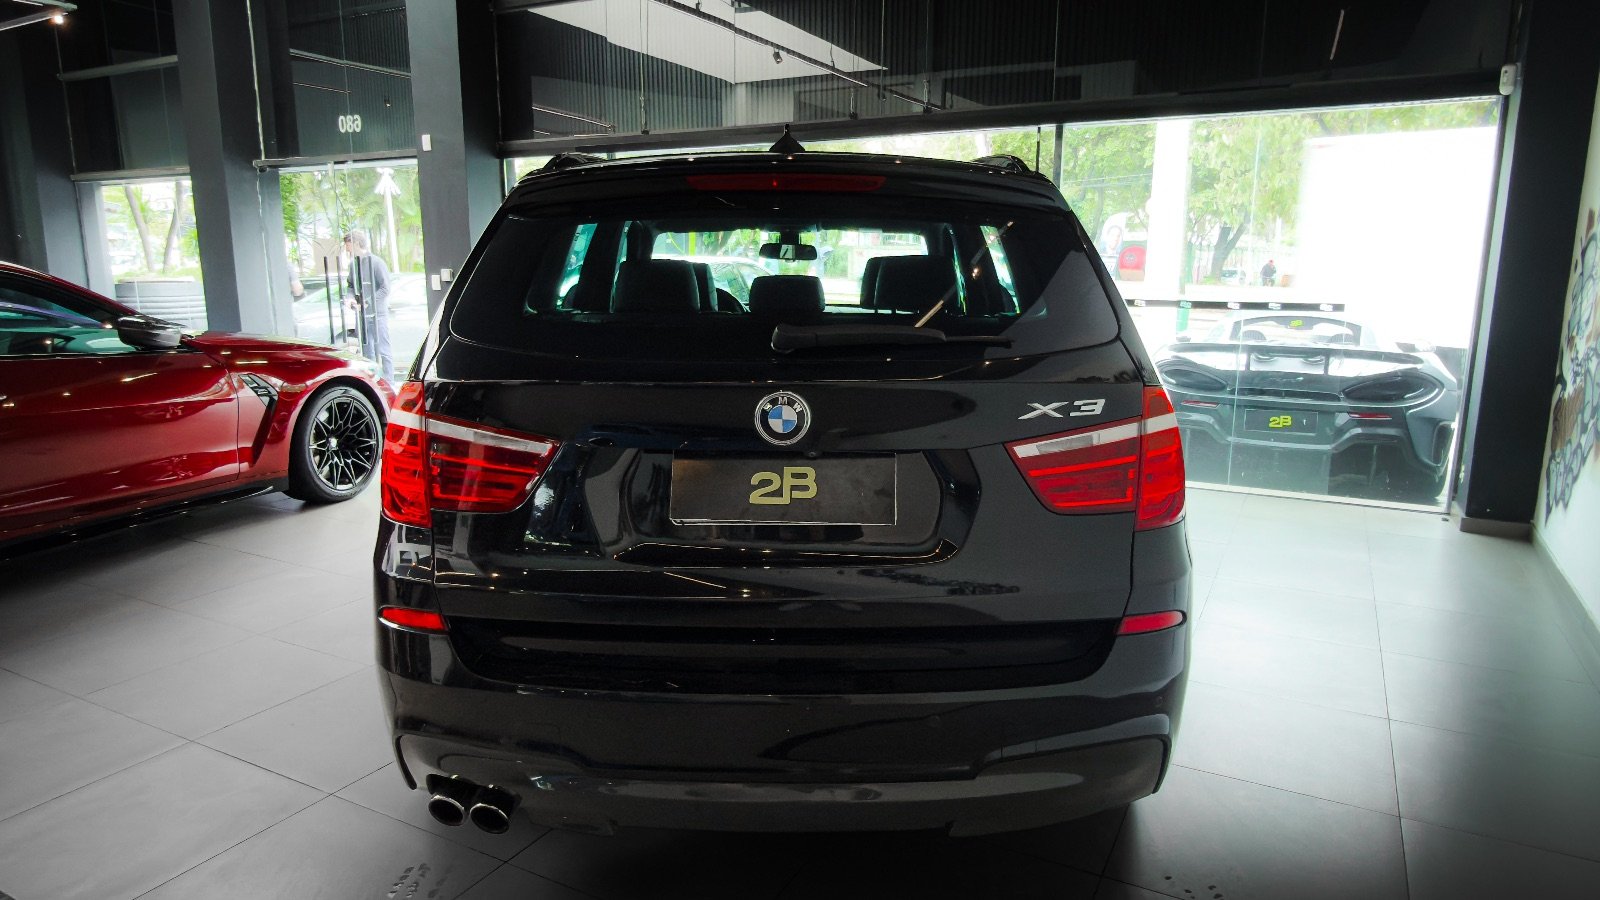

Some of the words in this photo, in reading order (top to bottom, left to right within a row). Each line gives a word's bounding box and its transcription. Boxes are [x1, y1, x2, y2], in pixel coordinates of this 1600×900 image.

[762, 396, 803, 413] BMW
[1017, 399, 1106, 420] X3
[1268, 415, 1292, 428] 2B
[749, 466, 818, 505] 2B
